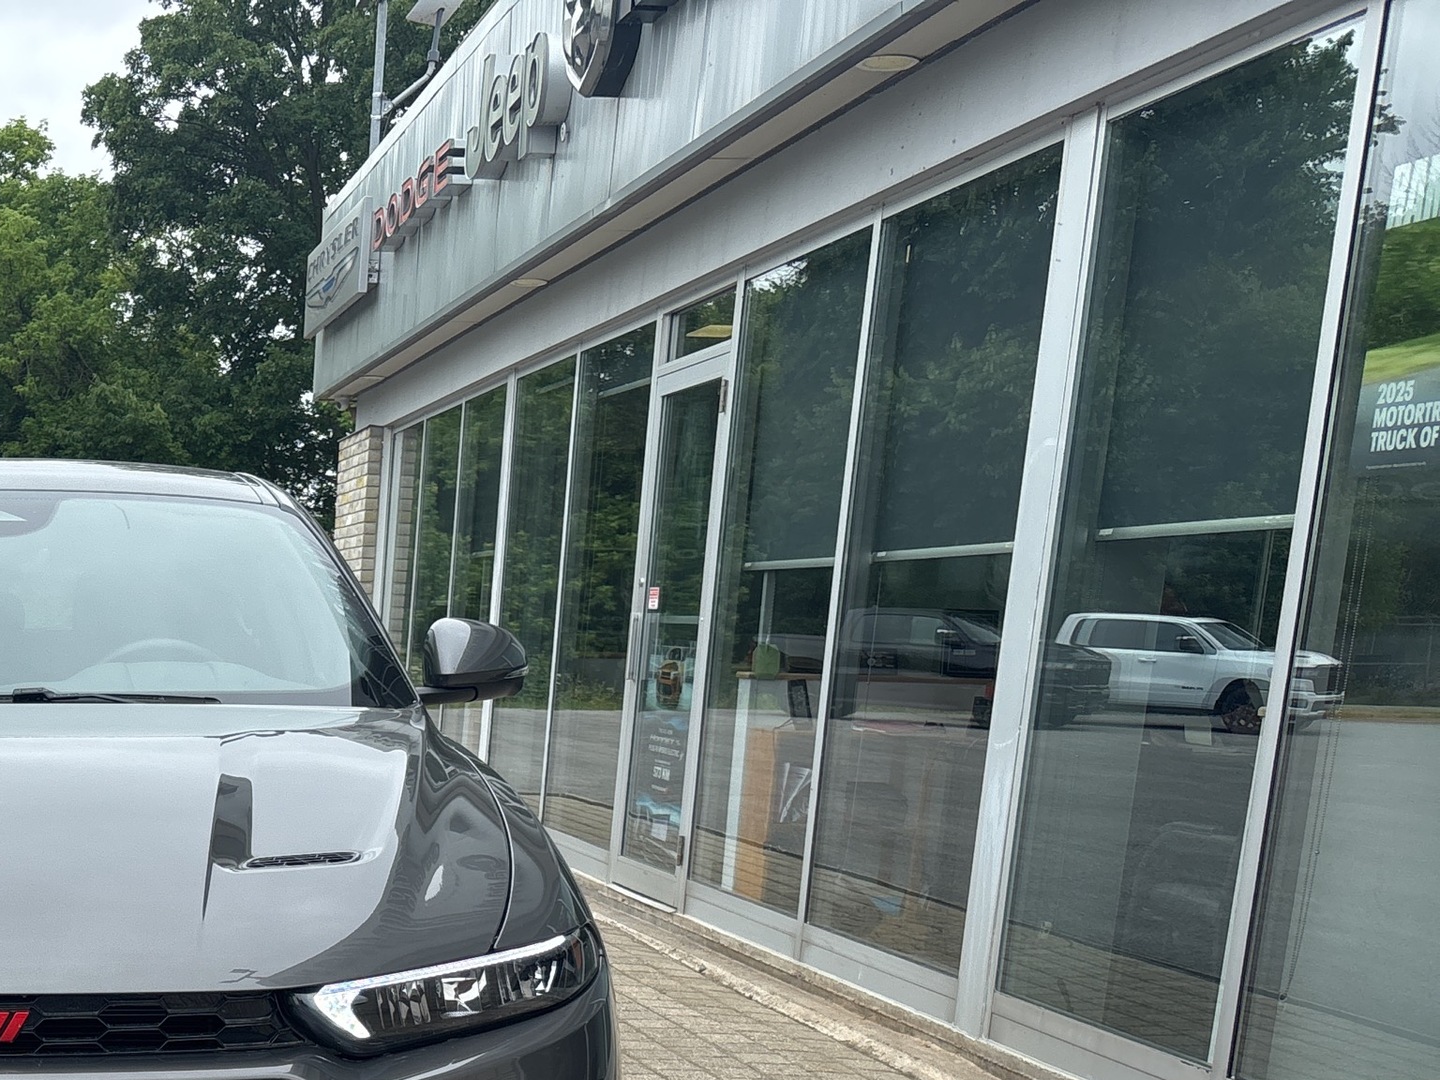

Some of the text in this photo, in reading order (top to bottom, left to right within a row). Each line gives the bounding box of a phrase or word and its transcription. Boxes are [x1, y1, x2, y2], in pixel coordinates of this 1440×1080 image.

[464, 31, 548, 181] Jeep
[372, 138, 454, 250] DODGE
[1376, 380, 1415, 405] 2025
[1370, 426, 1440, 452] TRUCK OF
